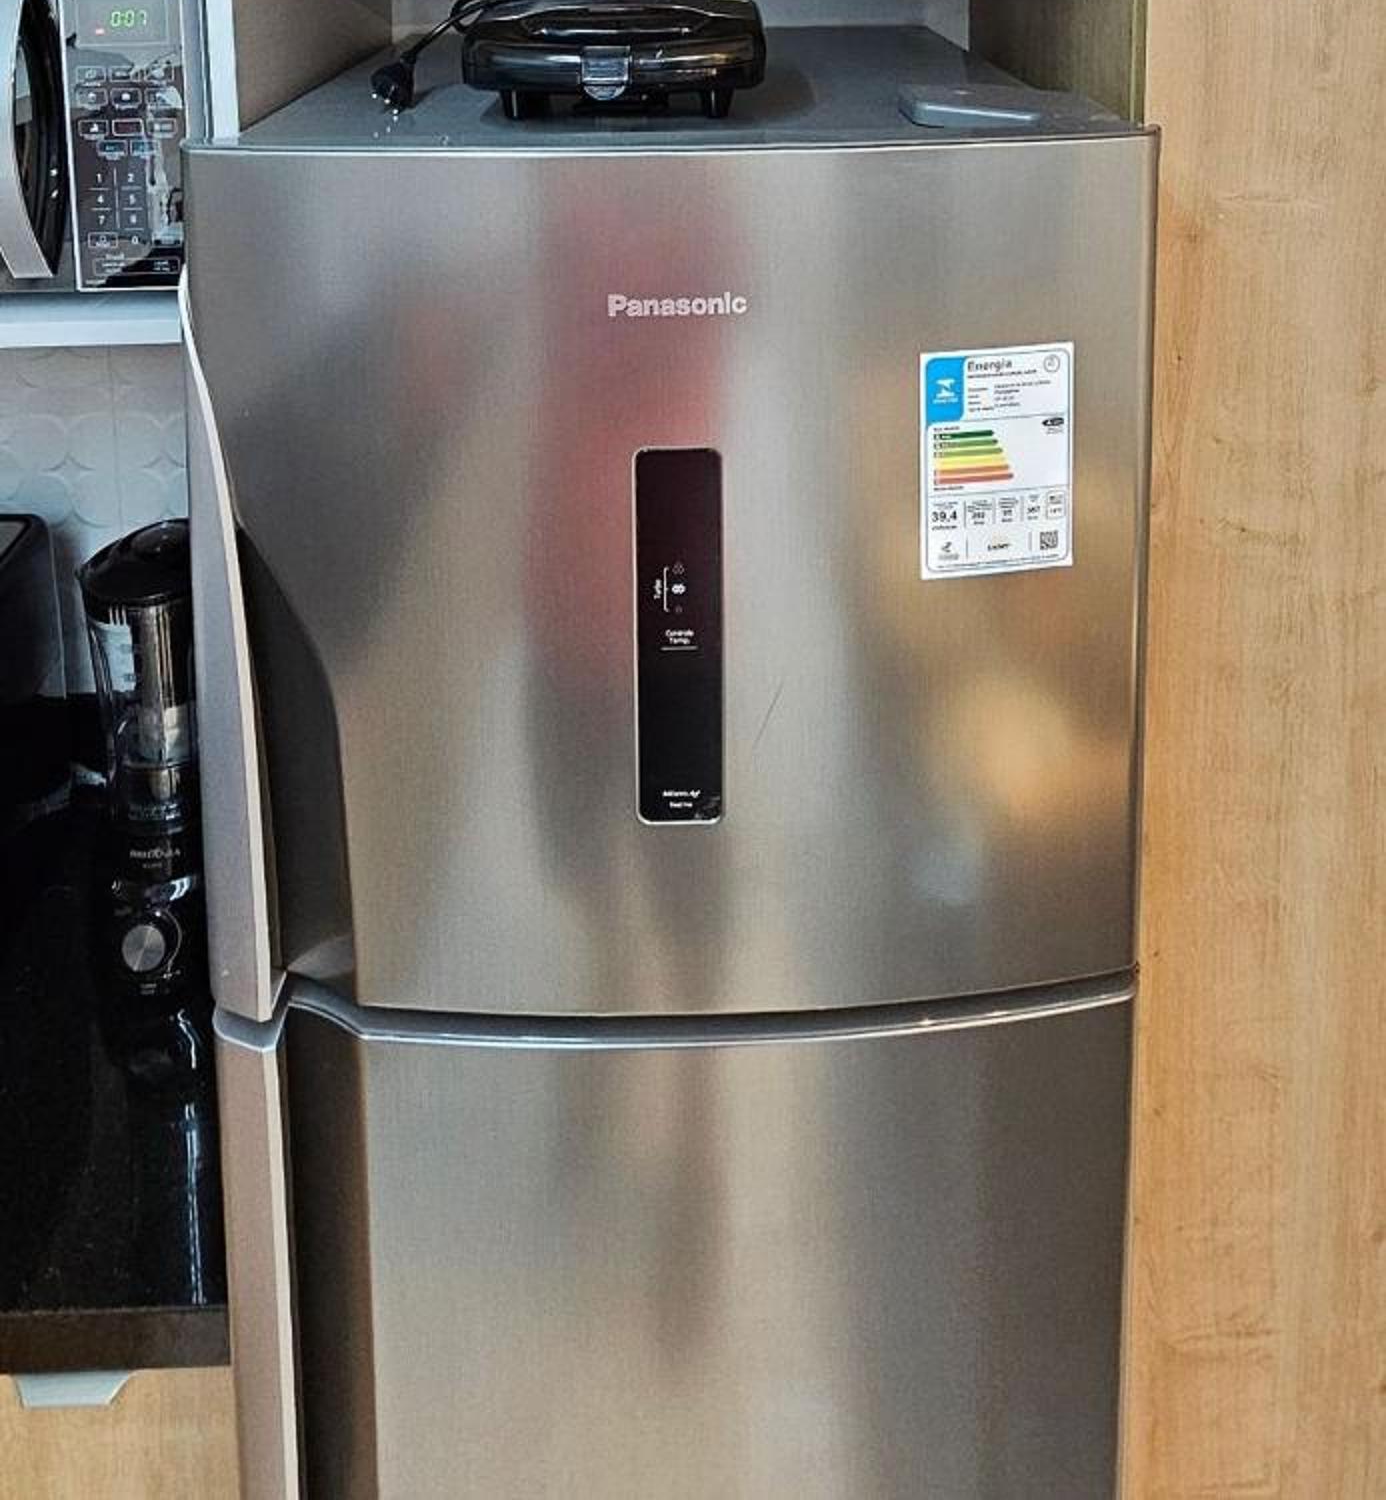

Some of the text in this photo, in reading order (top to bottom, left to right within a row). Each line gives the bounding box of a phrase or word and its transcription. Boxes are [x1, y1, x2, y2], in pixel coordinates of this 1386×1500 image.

[96, 173, 102, 183] 1
[127, 173, 135, 183] 2
[97, 195, 104, 204] 4
[98, 214, 105, 225] 7
[607, 291, 748, 318] Panasonic
[967, 357, 1013, 373] Energia
